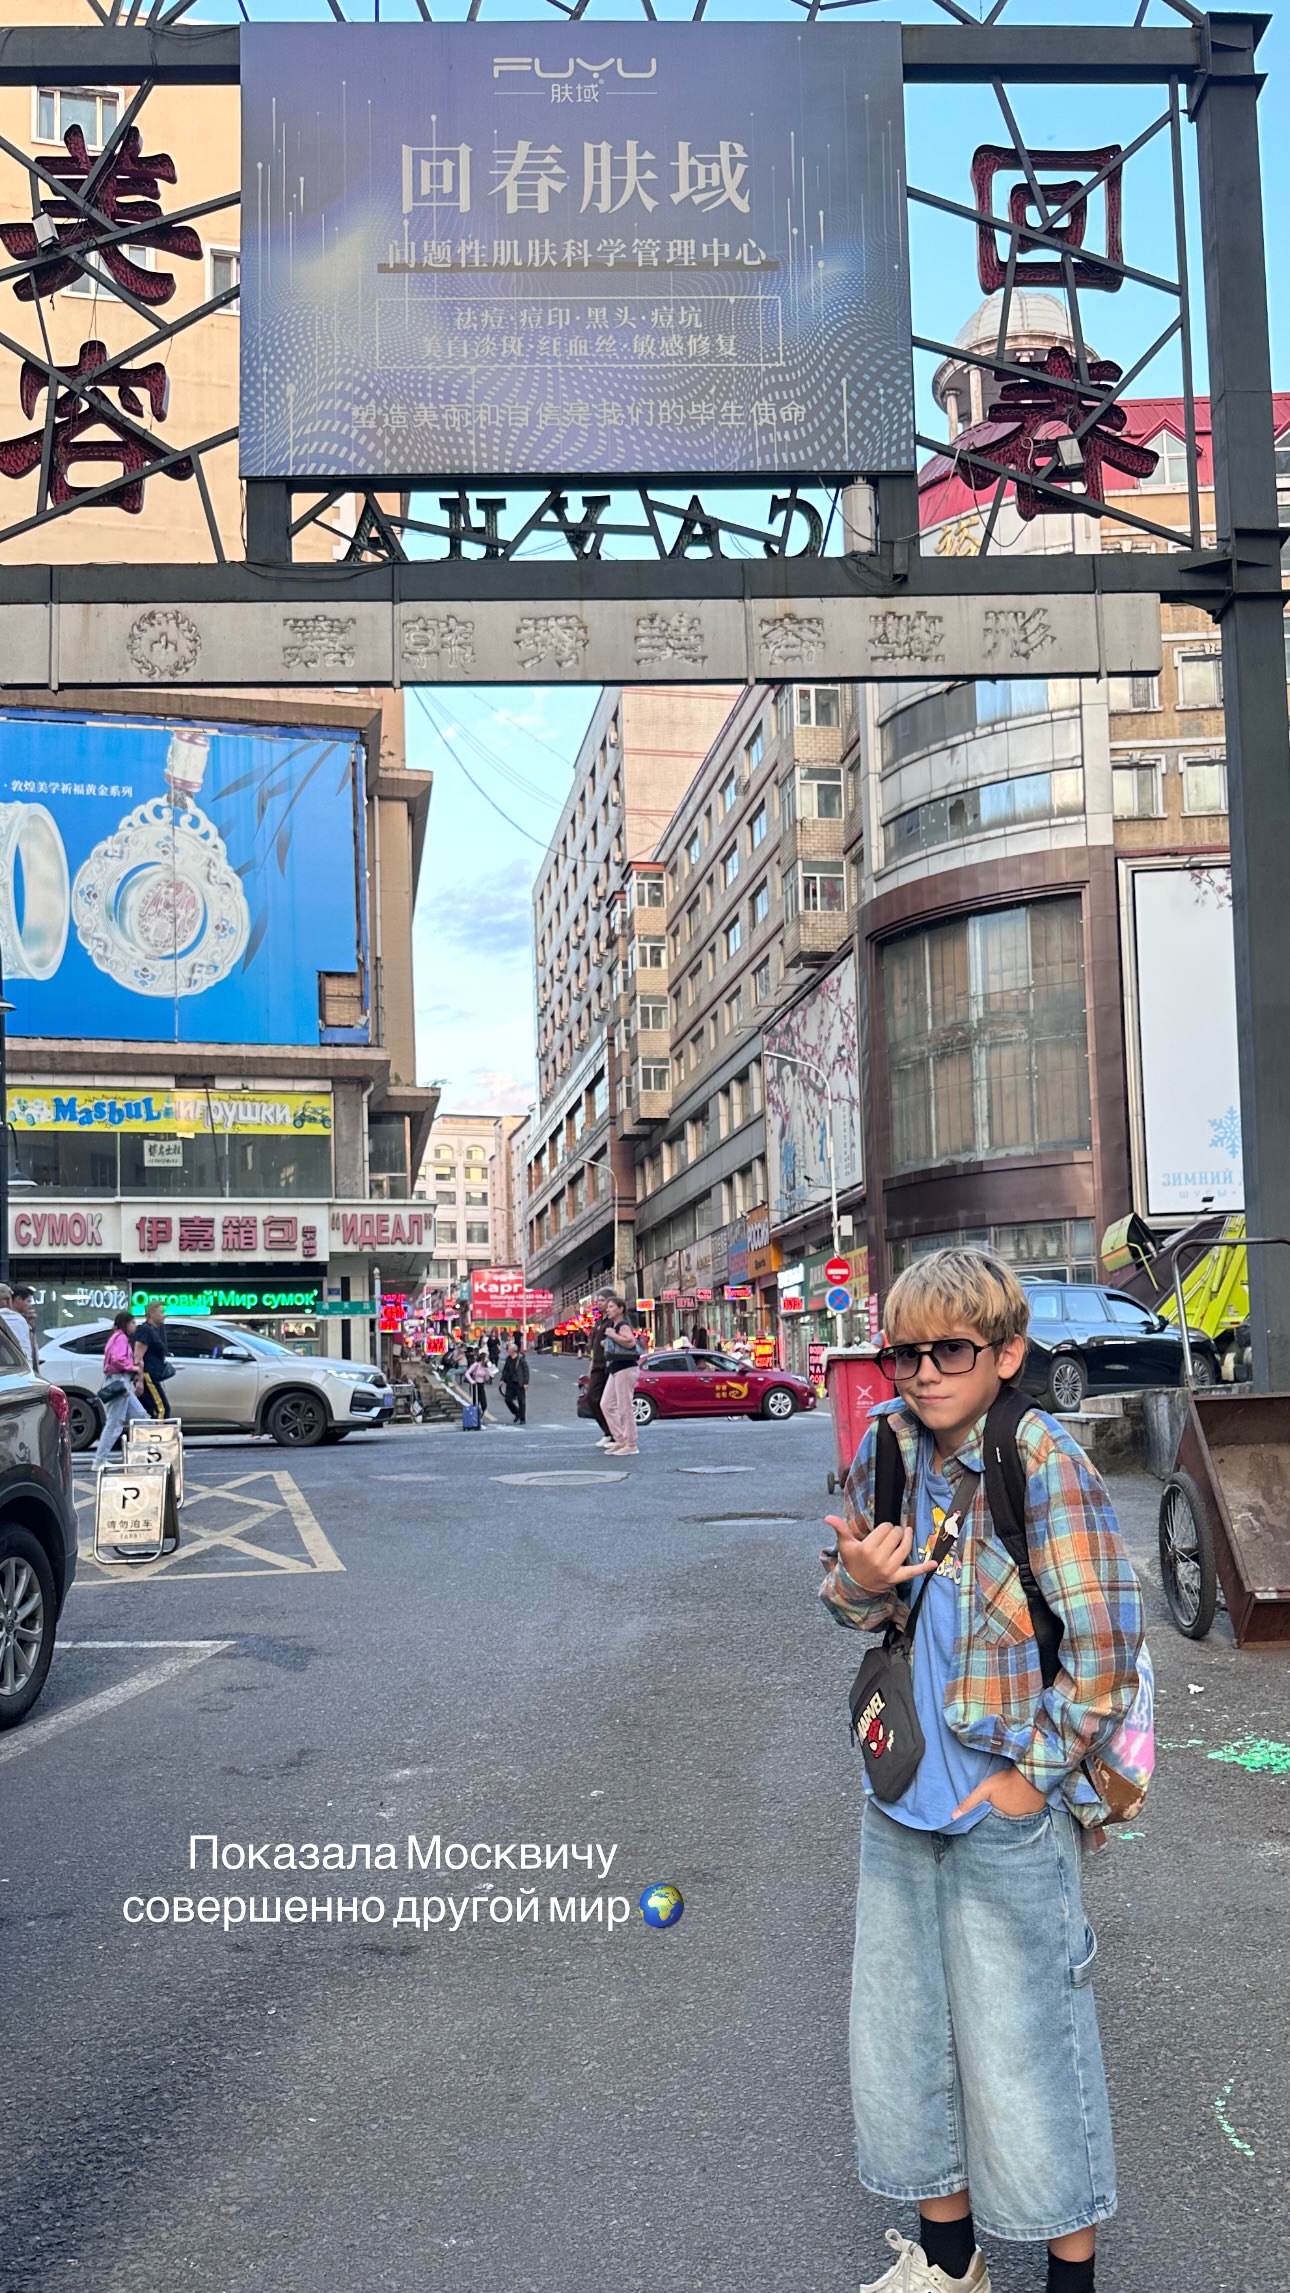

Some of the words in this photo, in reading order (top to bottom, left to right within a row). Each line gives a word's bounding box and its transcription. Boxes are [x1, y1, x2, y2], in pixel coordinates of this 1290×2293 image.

[493, 57, 657, 79] FUYU
[551, 83, 600, 103] 肤域
[401, 137, 752, 216] 回春肤域
[387, 236, 769, 270] 问题性肌肤科学管理中心
[1161, 1168, 1233, 1187] ЗИМНИЙ
[15, 1212, 103, 1246] СУМОК
[136, 1215, 298, 1252] 伊嘉箱包
